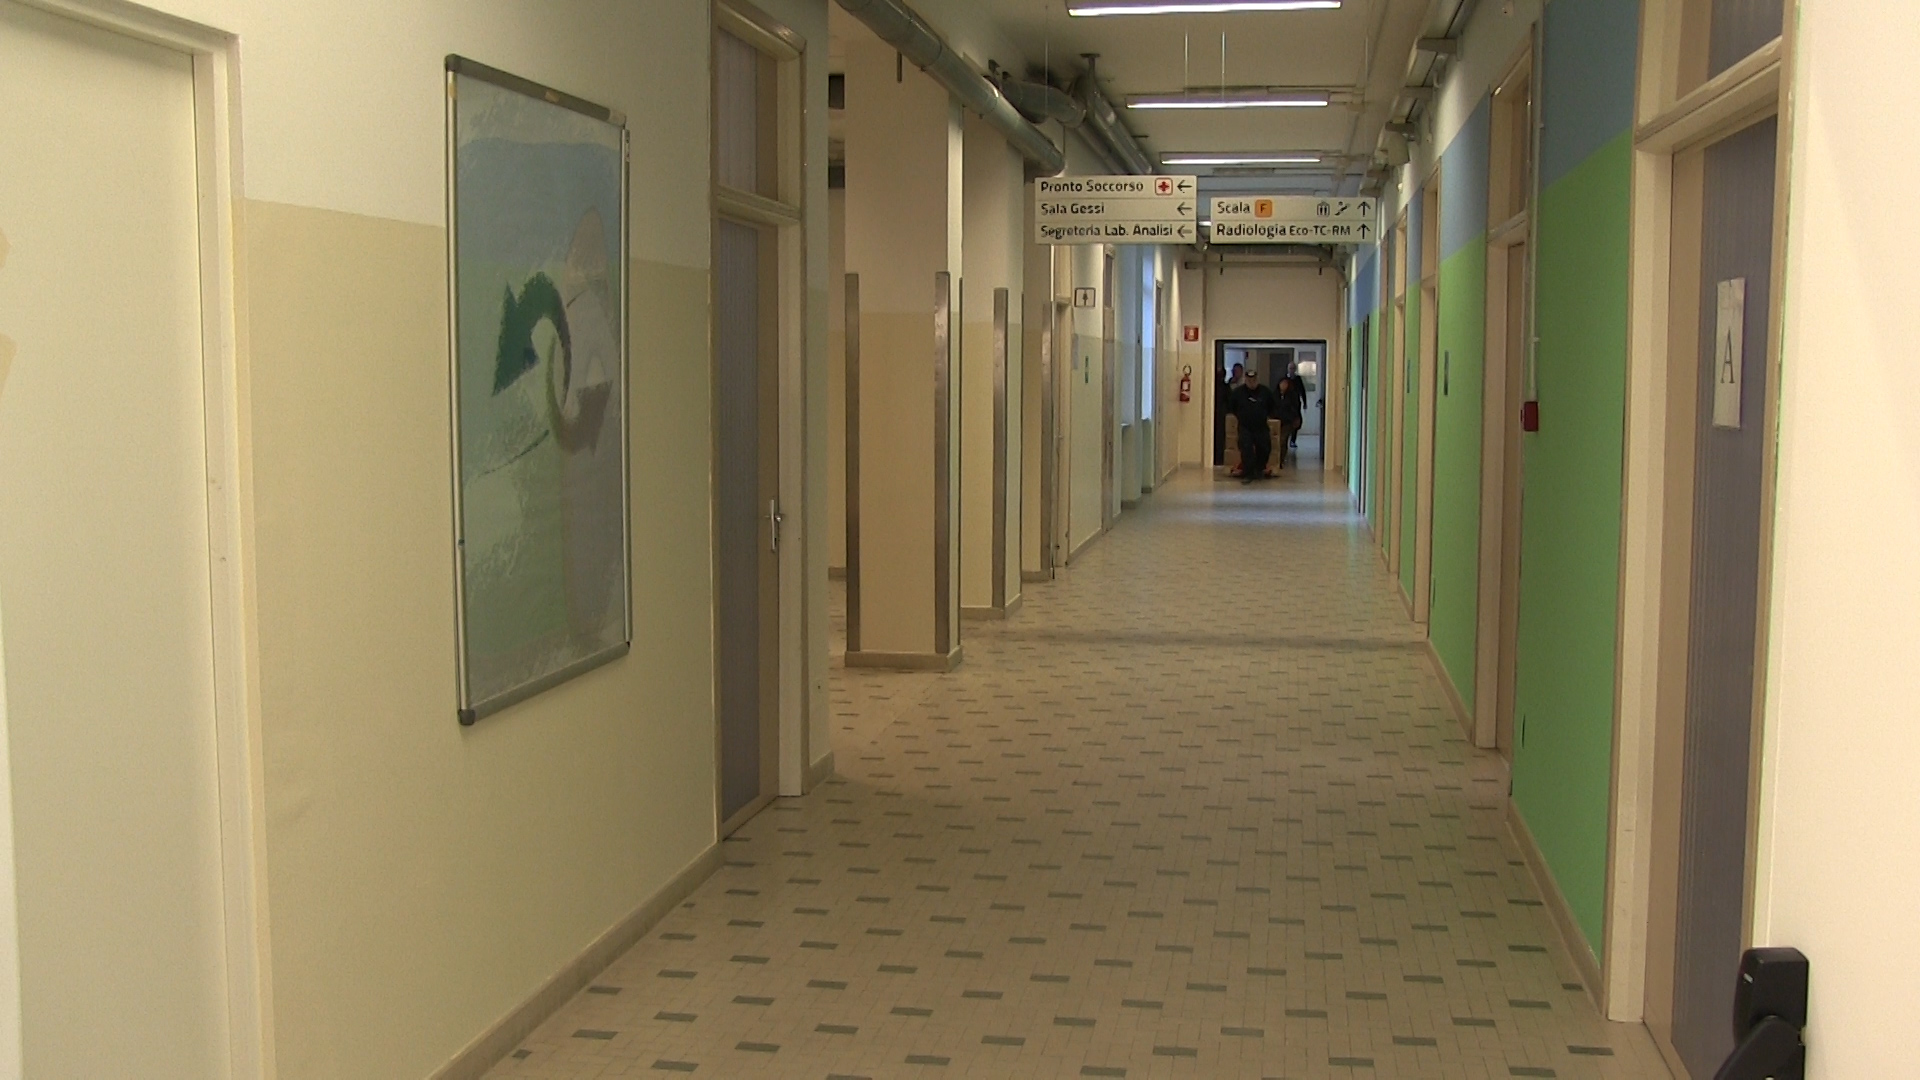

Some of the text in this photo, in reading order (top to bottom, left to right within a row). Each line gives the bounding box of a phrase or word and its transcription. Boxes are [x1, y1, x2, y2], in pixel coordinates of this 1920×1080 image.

[1041, 179, 1144, 192] Pronto Soccorso
[1041, 202, 1105, 215] Sala Gessi
[1217, 201, 1267, 214] Scala F
[1040, 223, 1173, 240] Segreteria Lab. Analisi
[1216, 223, 1287, 240] Radiologia
[1719, 326, 1735, 384] A
